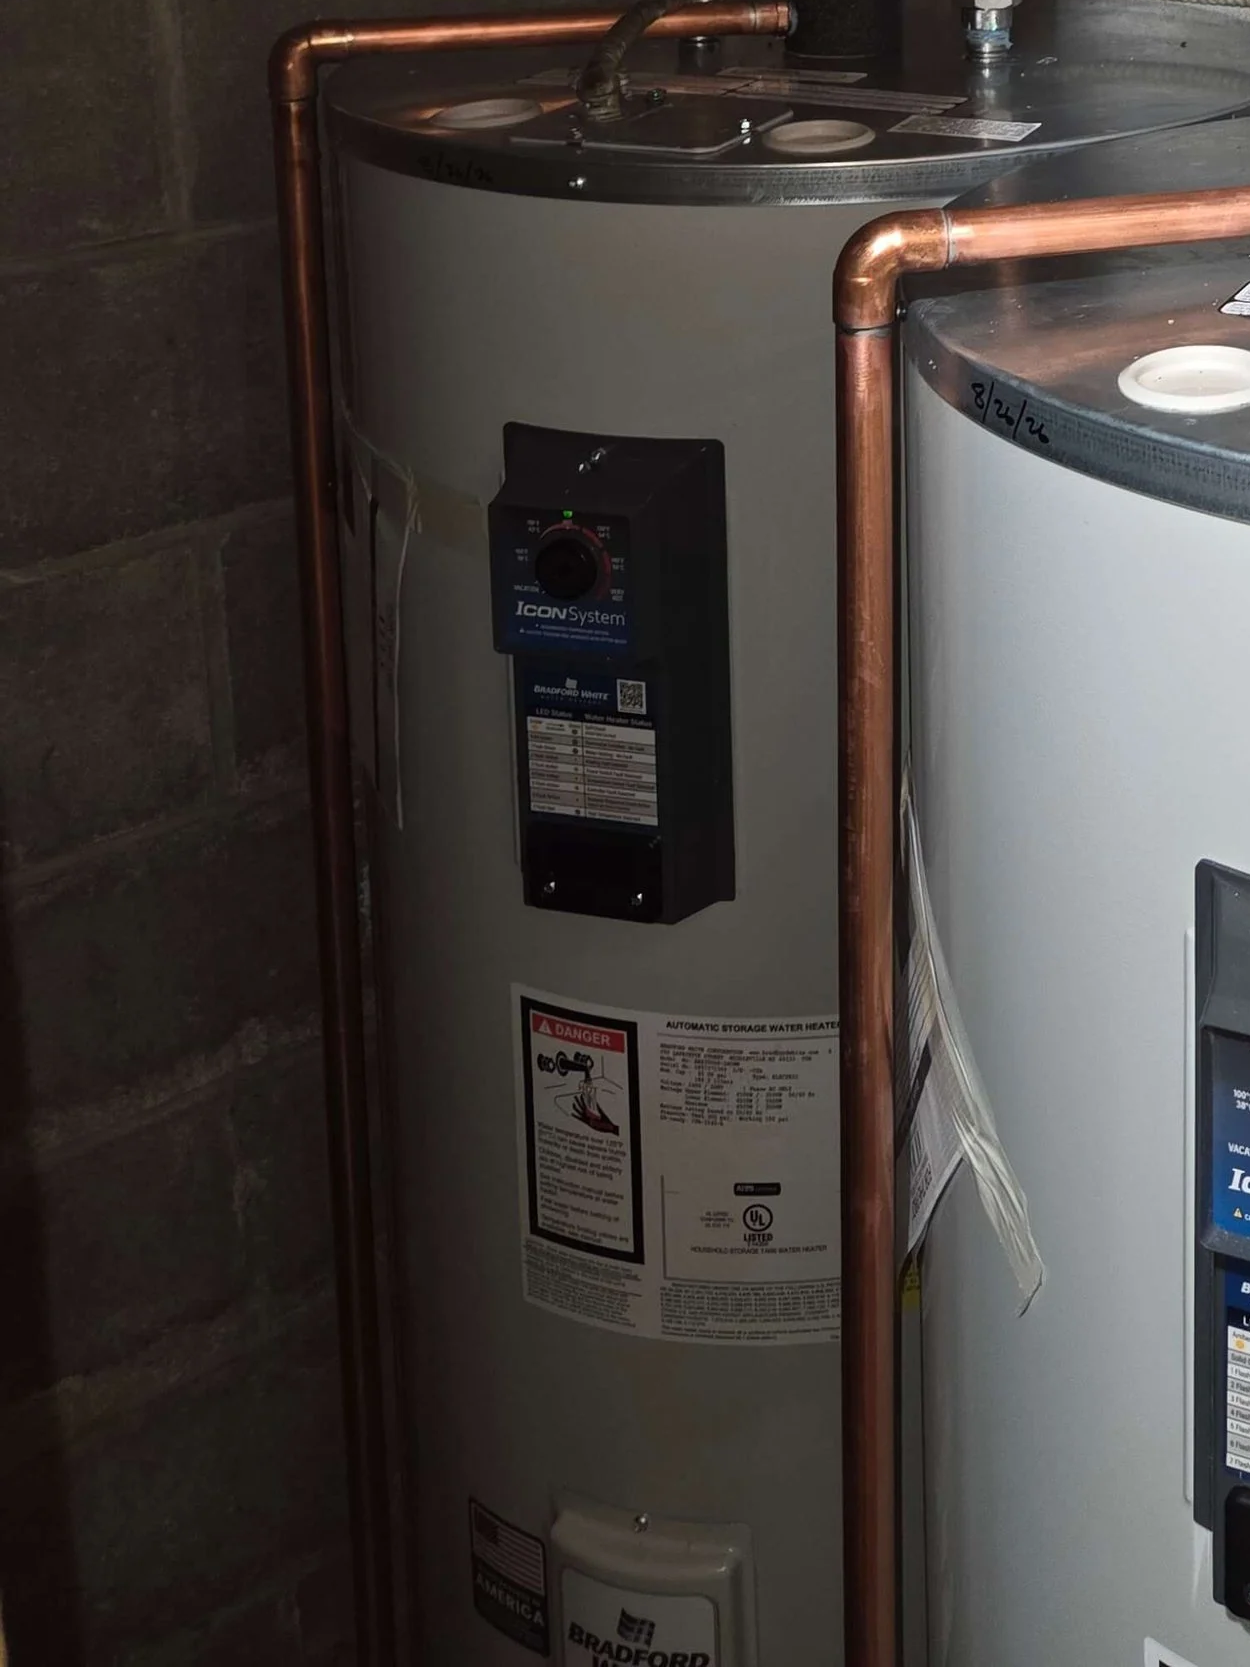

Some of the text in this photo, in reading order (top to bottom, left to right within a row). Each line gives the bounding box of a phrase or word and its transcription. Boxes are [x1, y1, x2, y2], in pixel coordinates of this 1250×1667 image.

[515, 601, 626, 626] ICON System
[533, 684, 579, 697] BRADFORD
[580, 689, 609, 701] WHITE
[555, 1023, 611, 1047] DANGER
[666, 1021, 719, 1032] AUTOMATIC
[722, 1024, 767, 1033] STORAGE
[769, 1024, 803, 1033] WATER
[750, 1210, 765, 1226] UL
[743, 1233, 774, 1242] LISTED
[475, 1573, 545, 1626] AMERICA
[568, 1621, 710, 1667] BRADFORD
